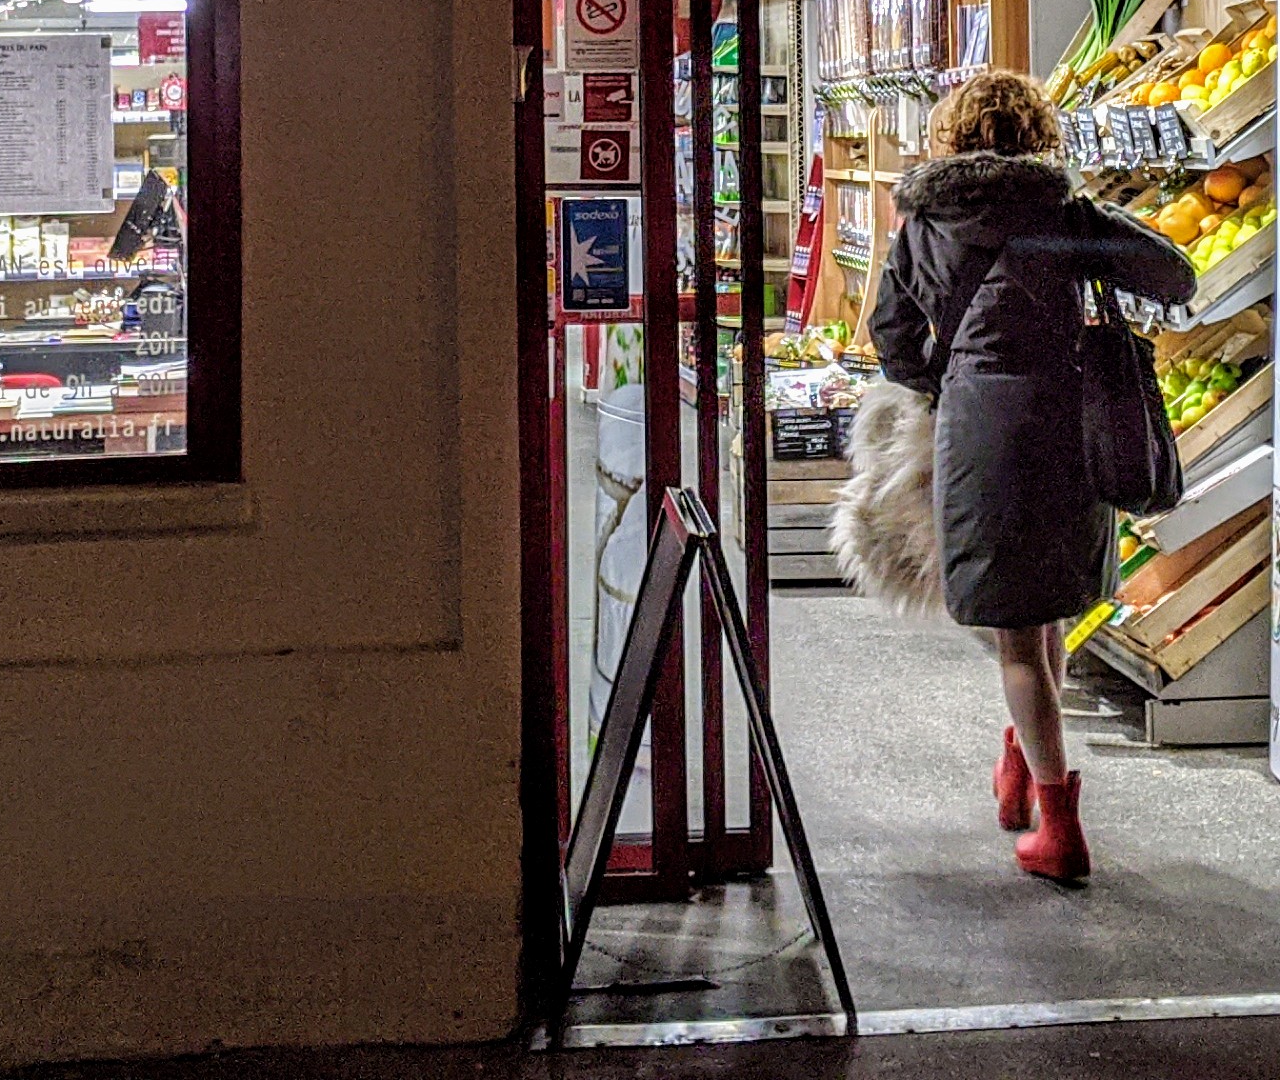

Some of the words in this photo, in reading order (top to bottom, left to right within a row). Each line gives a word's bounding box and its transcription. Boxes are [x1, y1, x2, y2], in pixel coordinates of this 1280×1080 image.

[574, 208, 620, 221] sodexo
[39, 253, 78, 275] est
[24, 298, 50, 317] au
[135, 331, 176, 356] 20h
[66, 373, 92, 400] 9h
